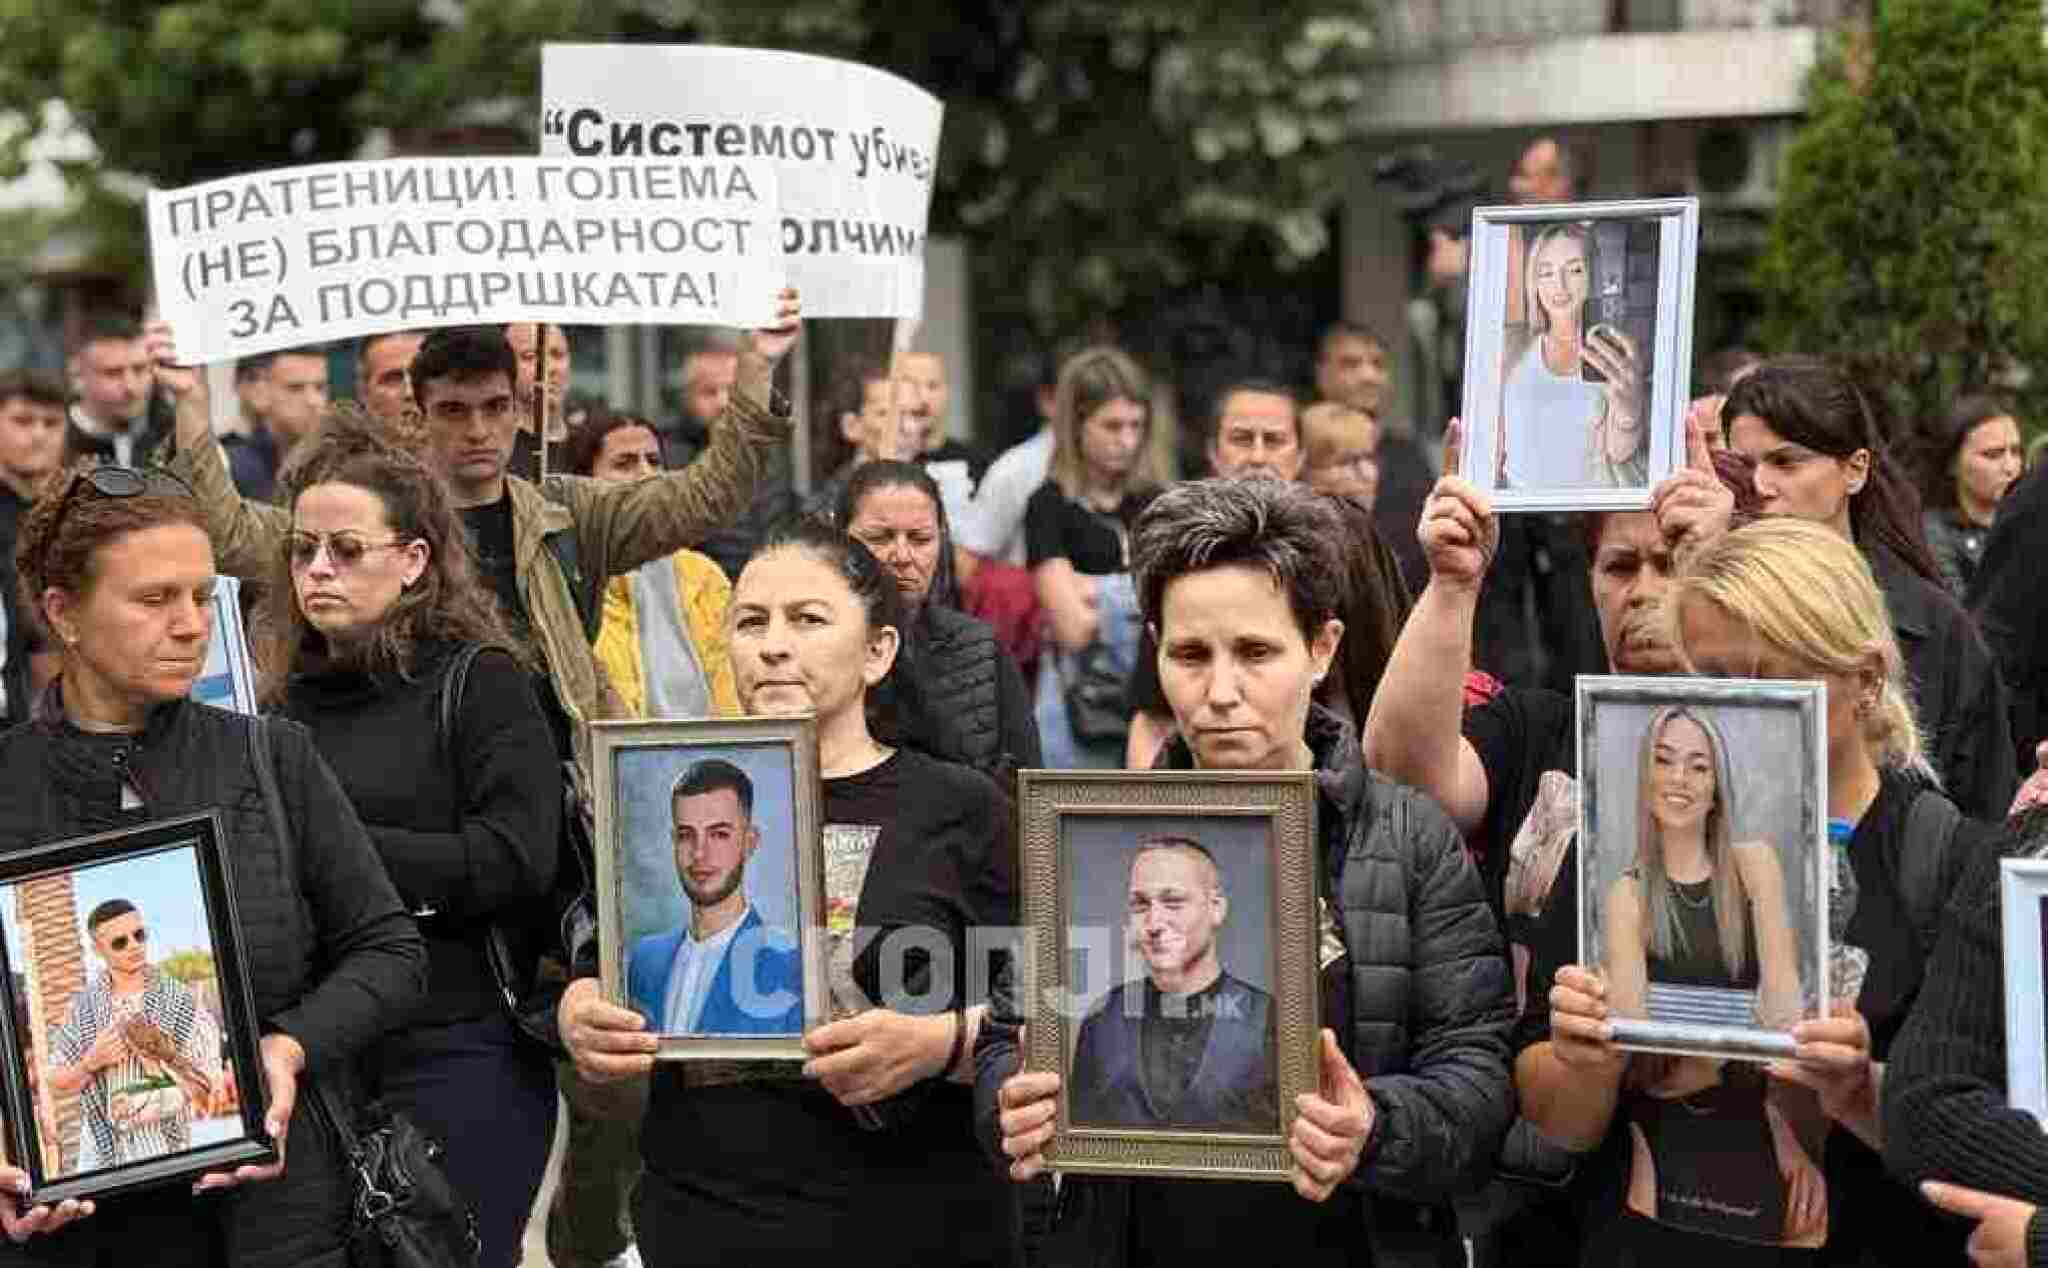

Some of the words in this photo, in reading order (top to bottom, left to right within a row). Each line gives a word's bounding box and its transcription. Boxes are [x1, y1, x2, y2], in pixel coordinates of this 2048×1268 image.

[544, 108, 834, 161] “Системот
[168, 165, 514, 237] ПРАТЕНИЦИ!
[537, 165, 758, 201] ГОЛЕМА
[182, 236, 287, 301] (НЕ)
[307, 217, 752, 268] БЛАГОДАРНОСТ
[228, 293, 301, 338] ЗА
[317, 271, 720, 323] ПОДДРШКАТА!
